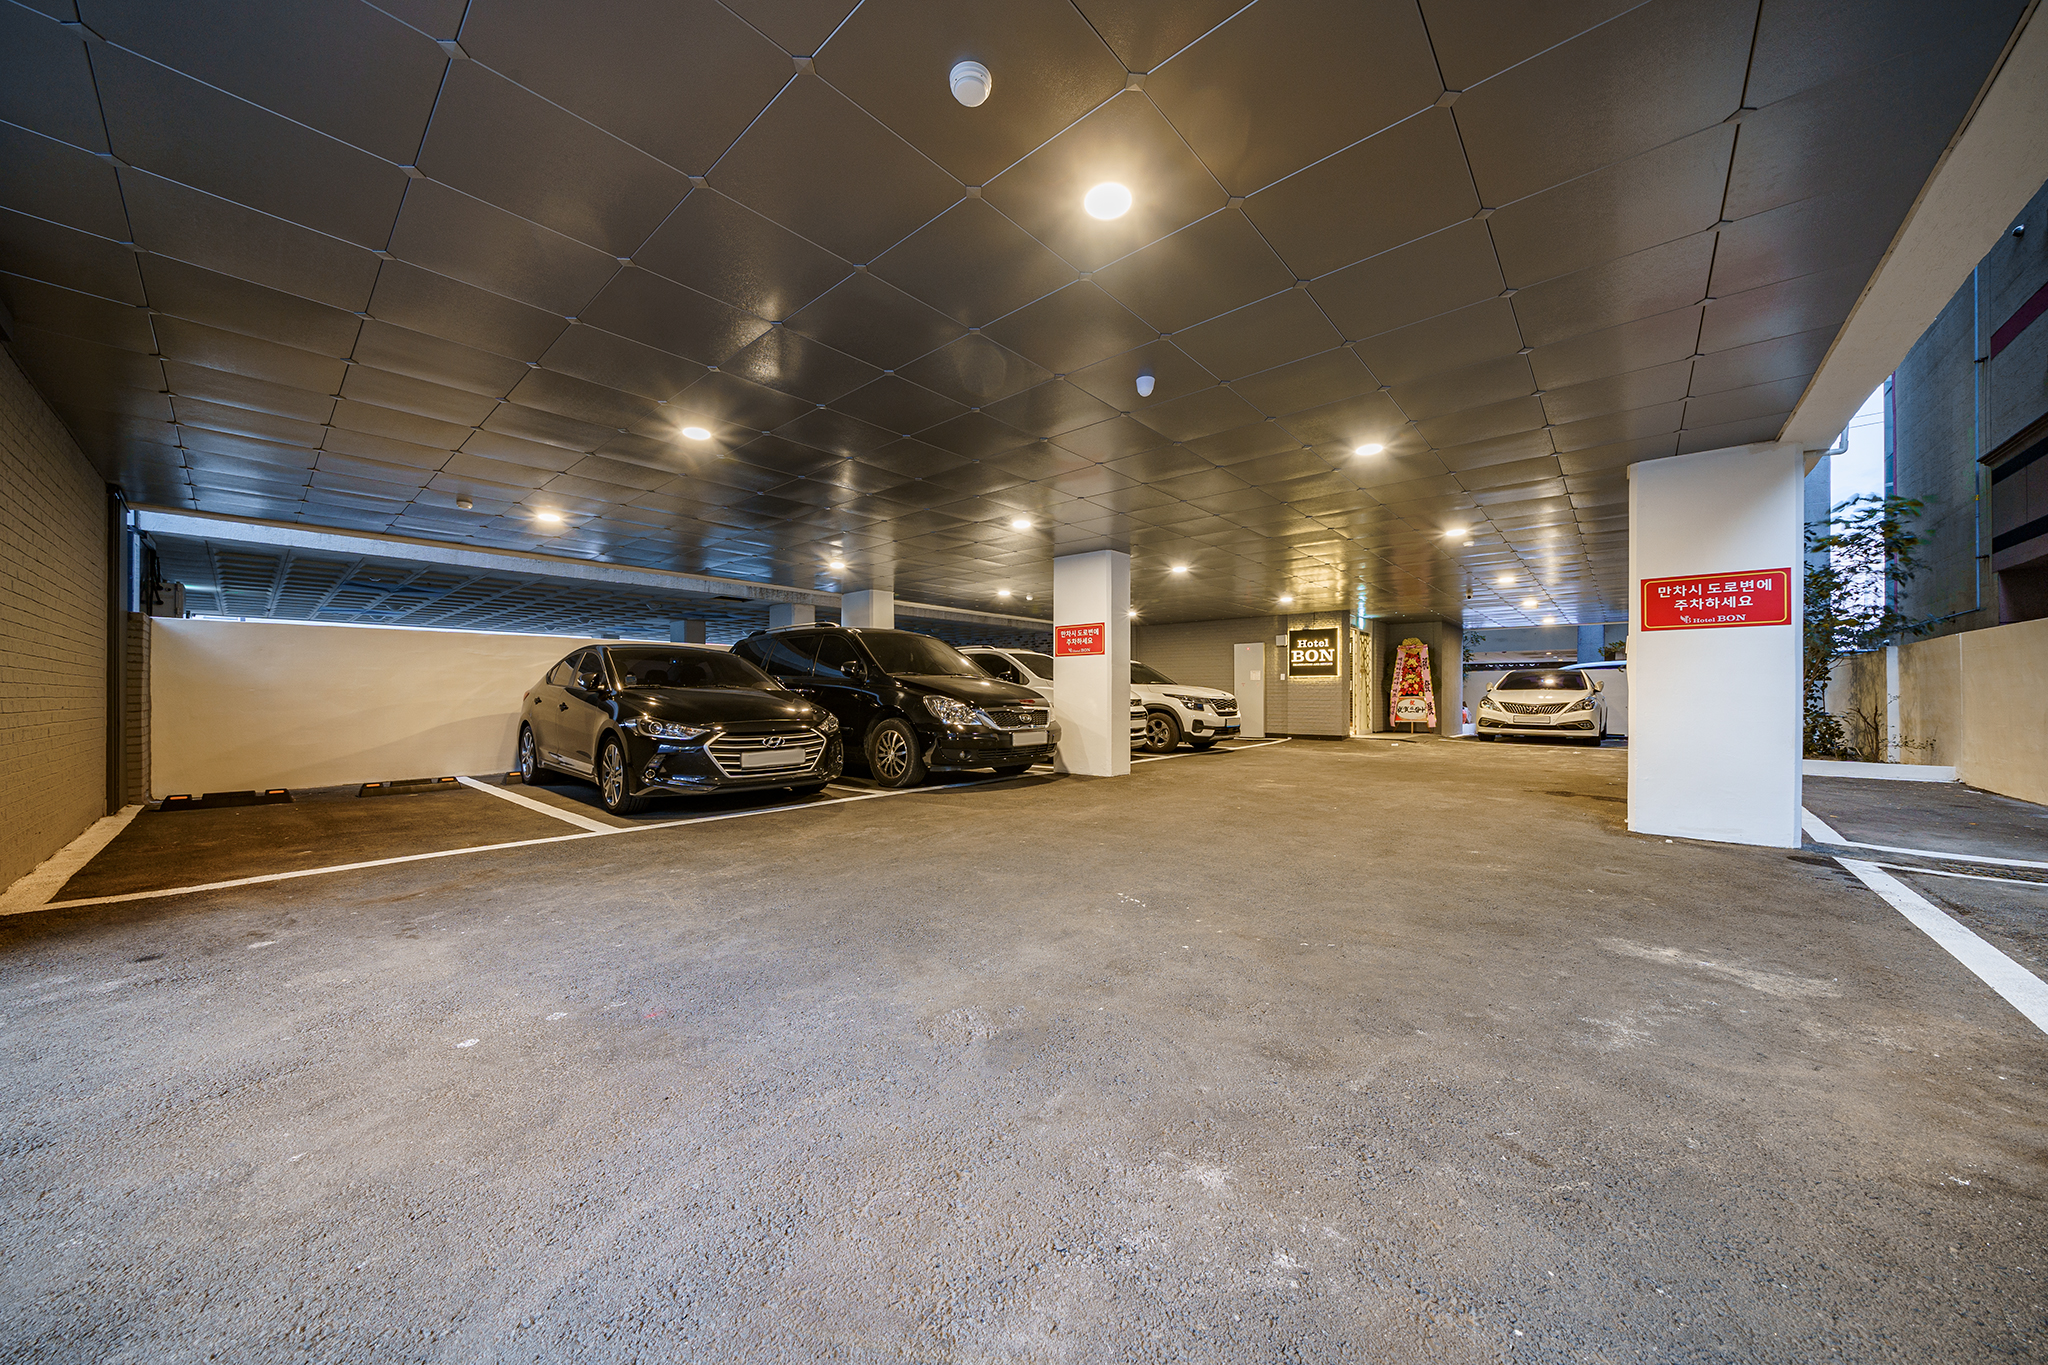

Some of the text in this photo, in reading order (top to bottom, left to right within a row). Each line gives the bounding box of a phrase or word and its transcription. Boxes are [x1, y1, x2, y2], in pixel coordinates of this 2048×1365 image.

[1658, 578, 1772, 598] 만차시 도로변에
[1674, 595, 1753, 611] 주차하세요
[1717, 614, 1746, 622] BON
[1297, 638, 1329, 648] Hotel
[1291, 649, 1335, 662] BON
